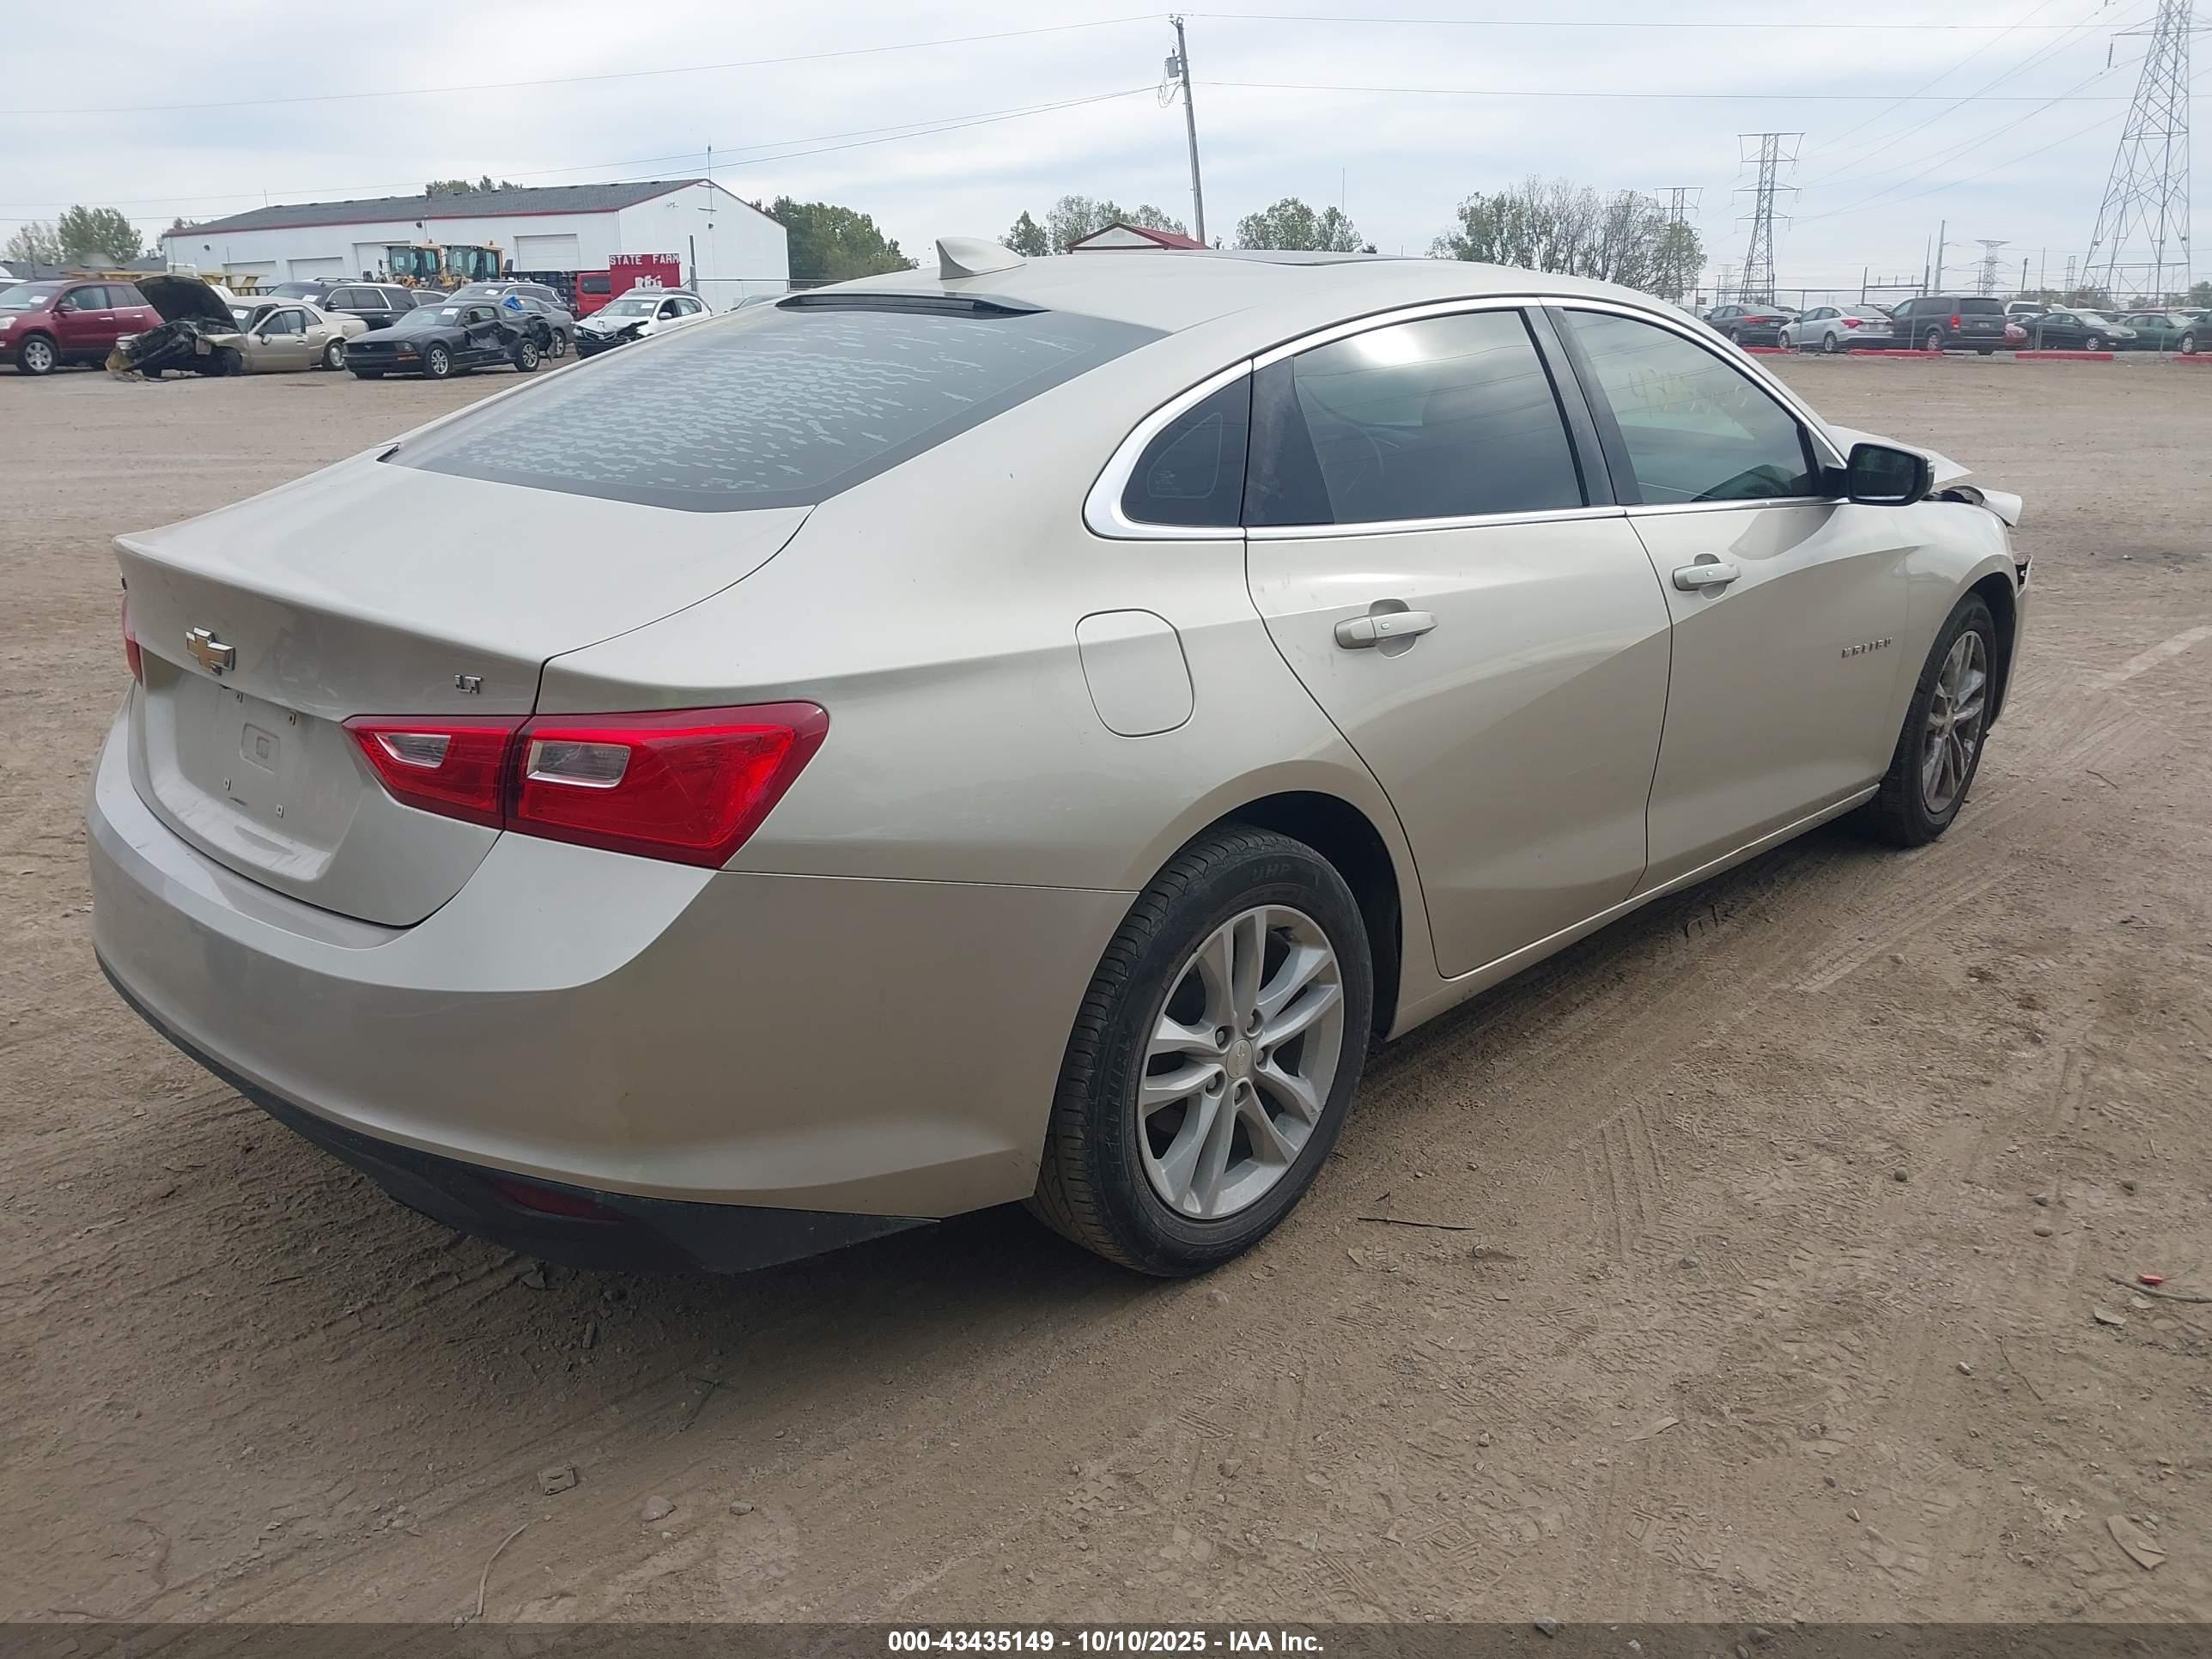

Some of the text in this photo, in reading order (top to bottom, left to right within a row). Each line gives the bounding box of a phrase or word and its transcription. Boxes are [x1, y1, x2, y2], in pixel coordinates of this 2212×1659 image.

[610, 252, 680, 265] STATE FARM
[453, 673, 483, 695] LT
